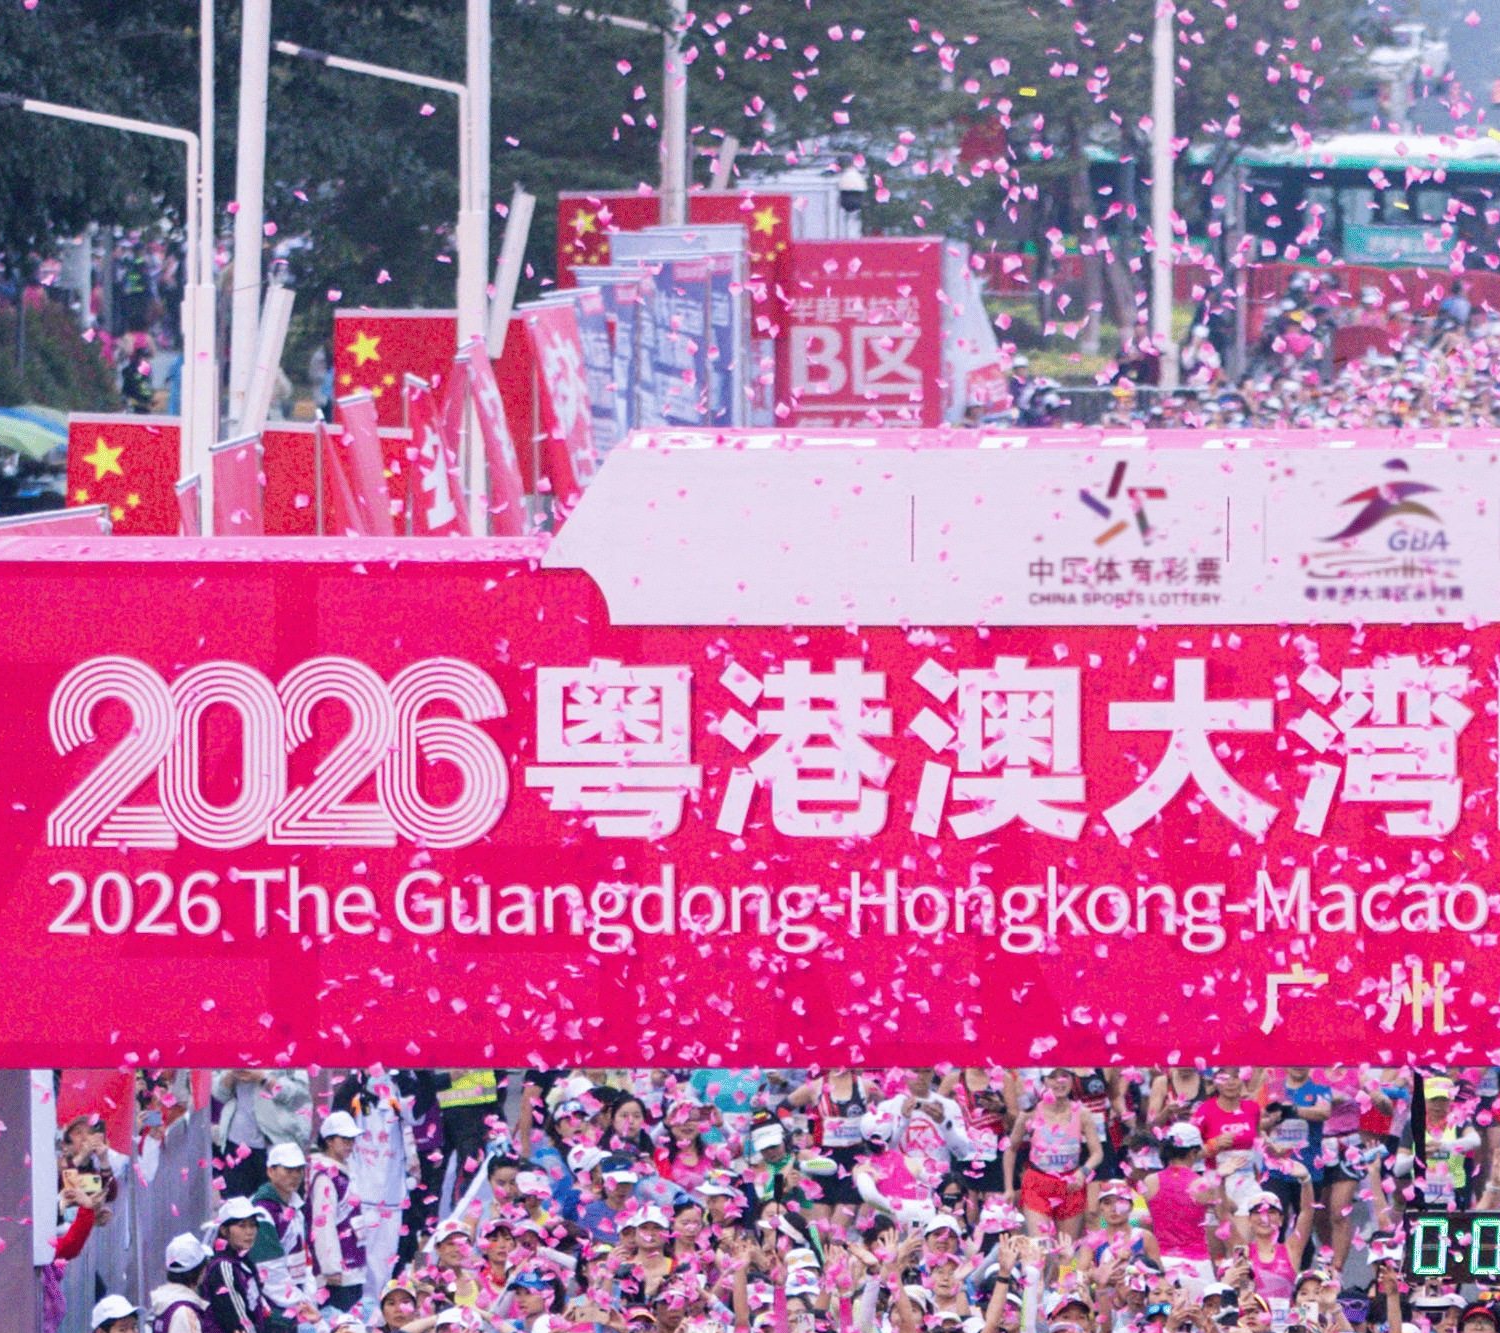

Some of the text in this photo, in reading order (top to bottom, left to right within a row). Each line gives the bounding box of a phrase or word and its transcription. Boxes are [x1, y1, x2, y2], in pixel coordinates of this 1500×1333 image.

[789, 326, 922, 396] B区
[1388, 530, 1450, 553] GBA
[1029, 557, 1221, 586] 中国体育彩票
[1029, 592, 1221, 607] CHINA SPORTS LOTTERY
[48, 871, 220, 933] 2026
[233, 869, 375, 933] The
